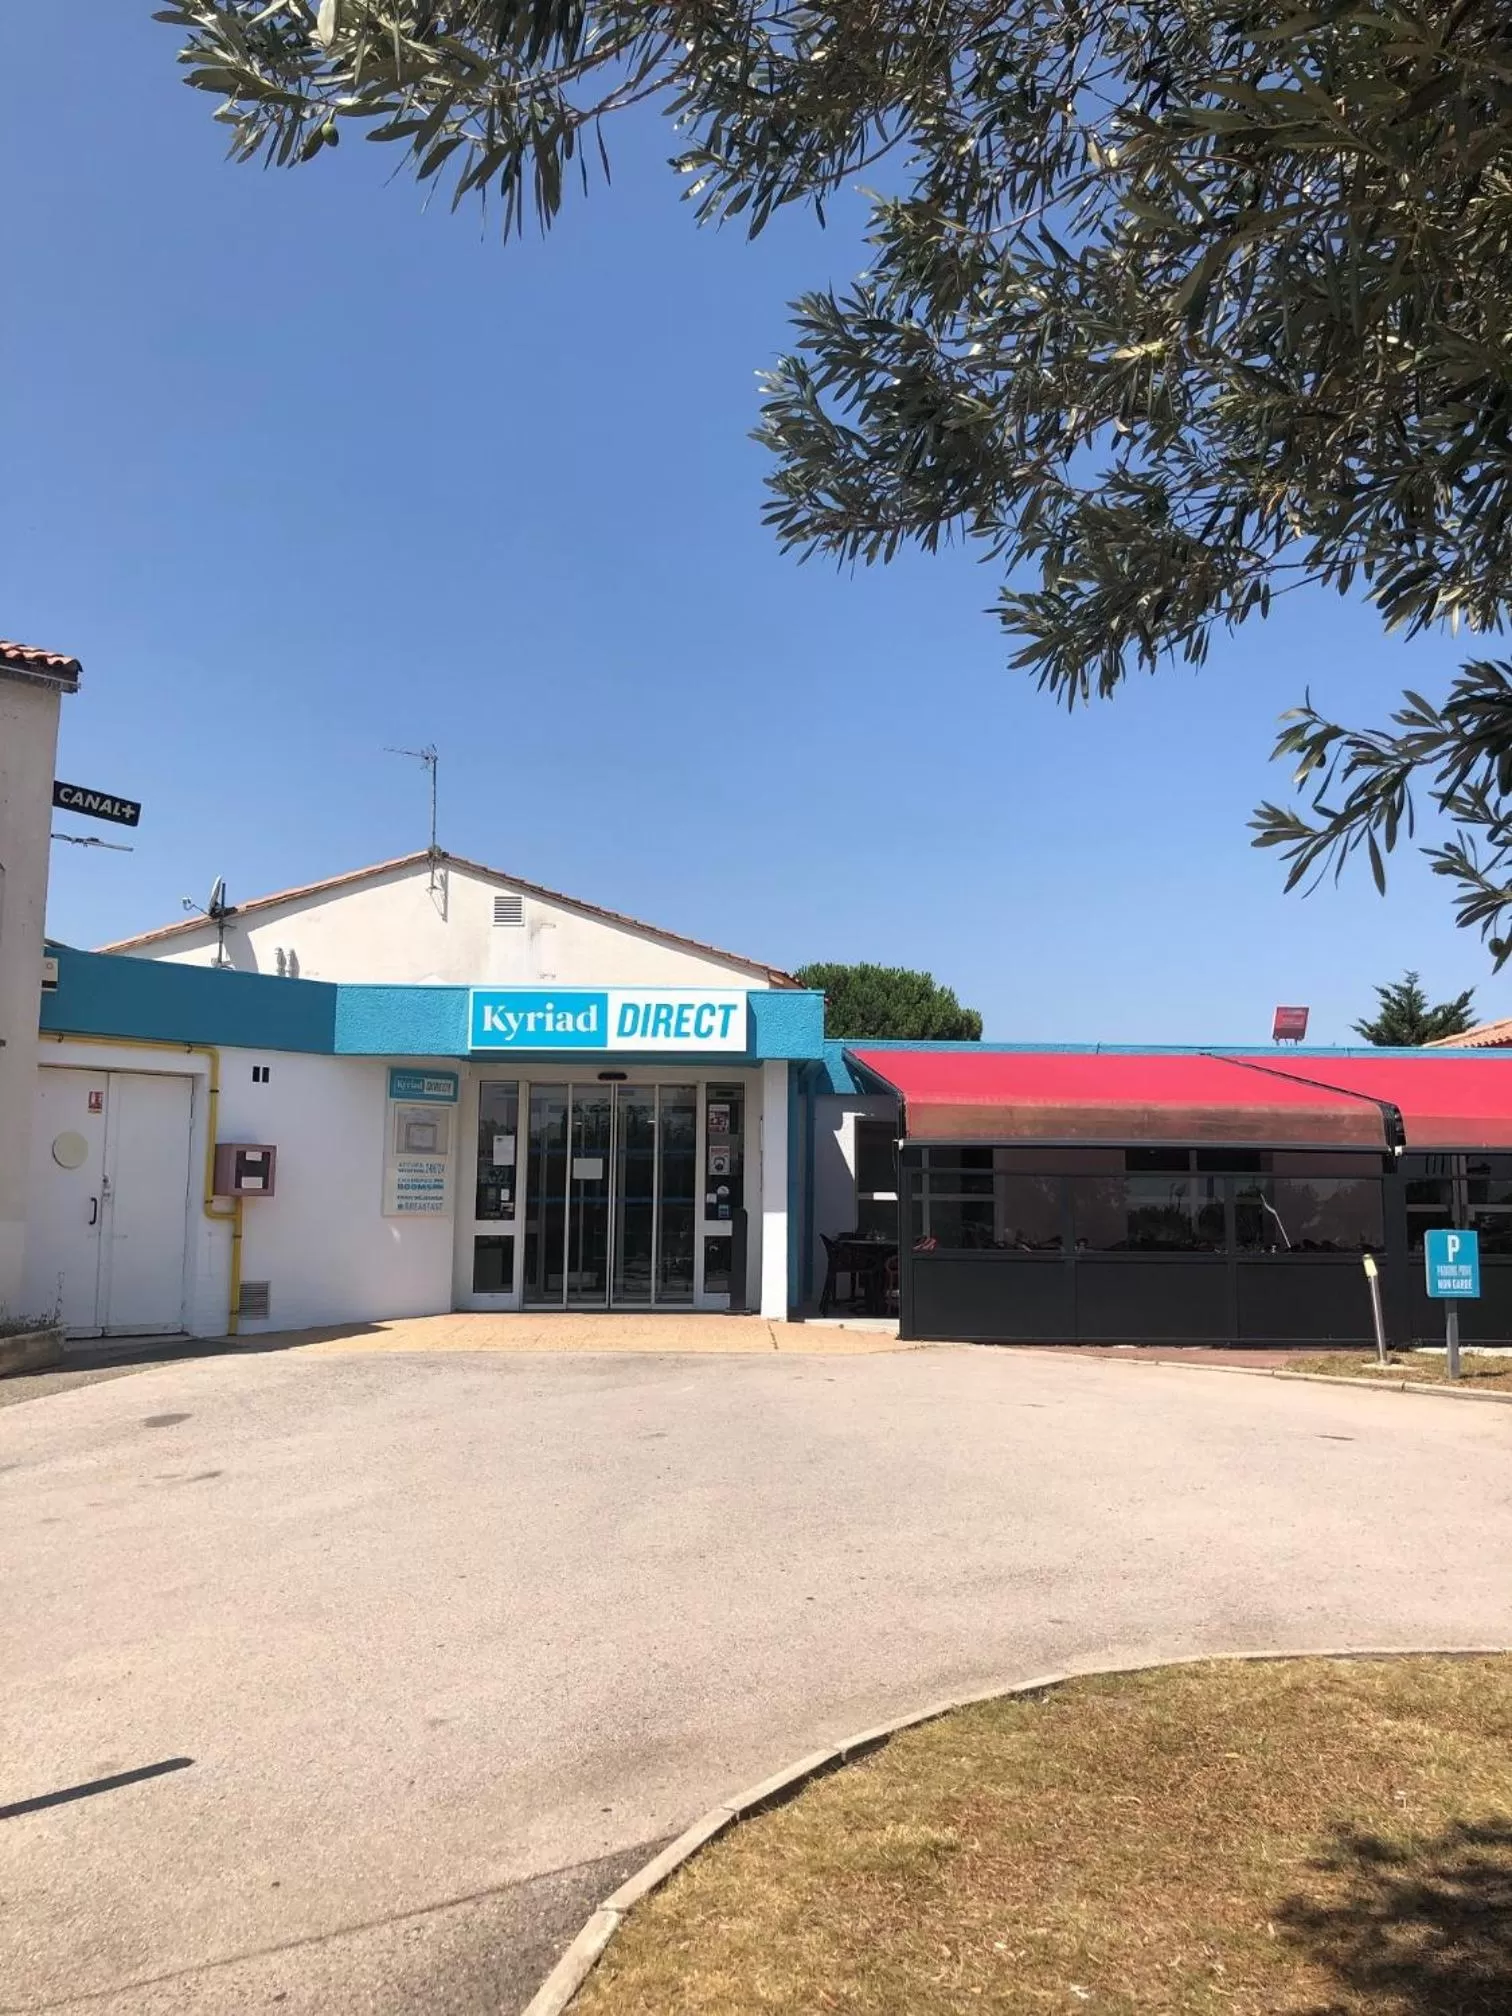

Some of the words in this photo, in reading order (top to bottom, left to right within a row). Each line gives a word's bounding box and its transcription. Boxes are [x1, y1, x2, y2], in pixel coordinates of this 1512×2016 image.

[59, 787, 136, 819] CANAL+
[483, 1002, 598, 1041] Kyriad
[616, 1003, 738, 1039] DIRECT
[1447, 1234, 1460, 1263] P
[1437, 1279, 1451, 1290] NON
